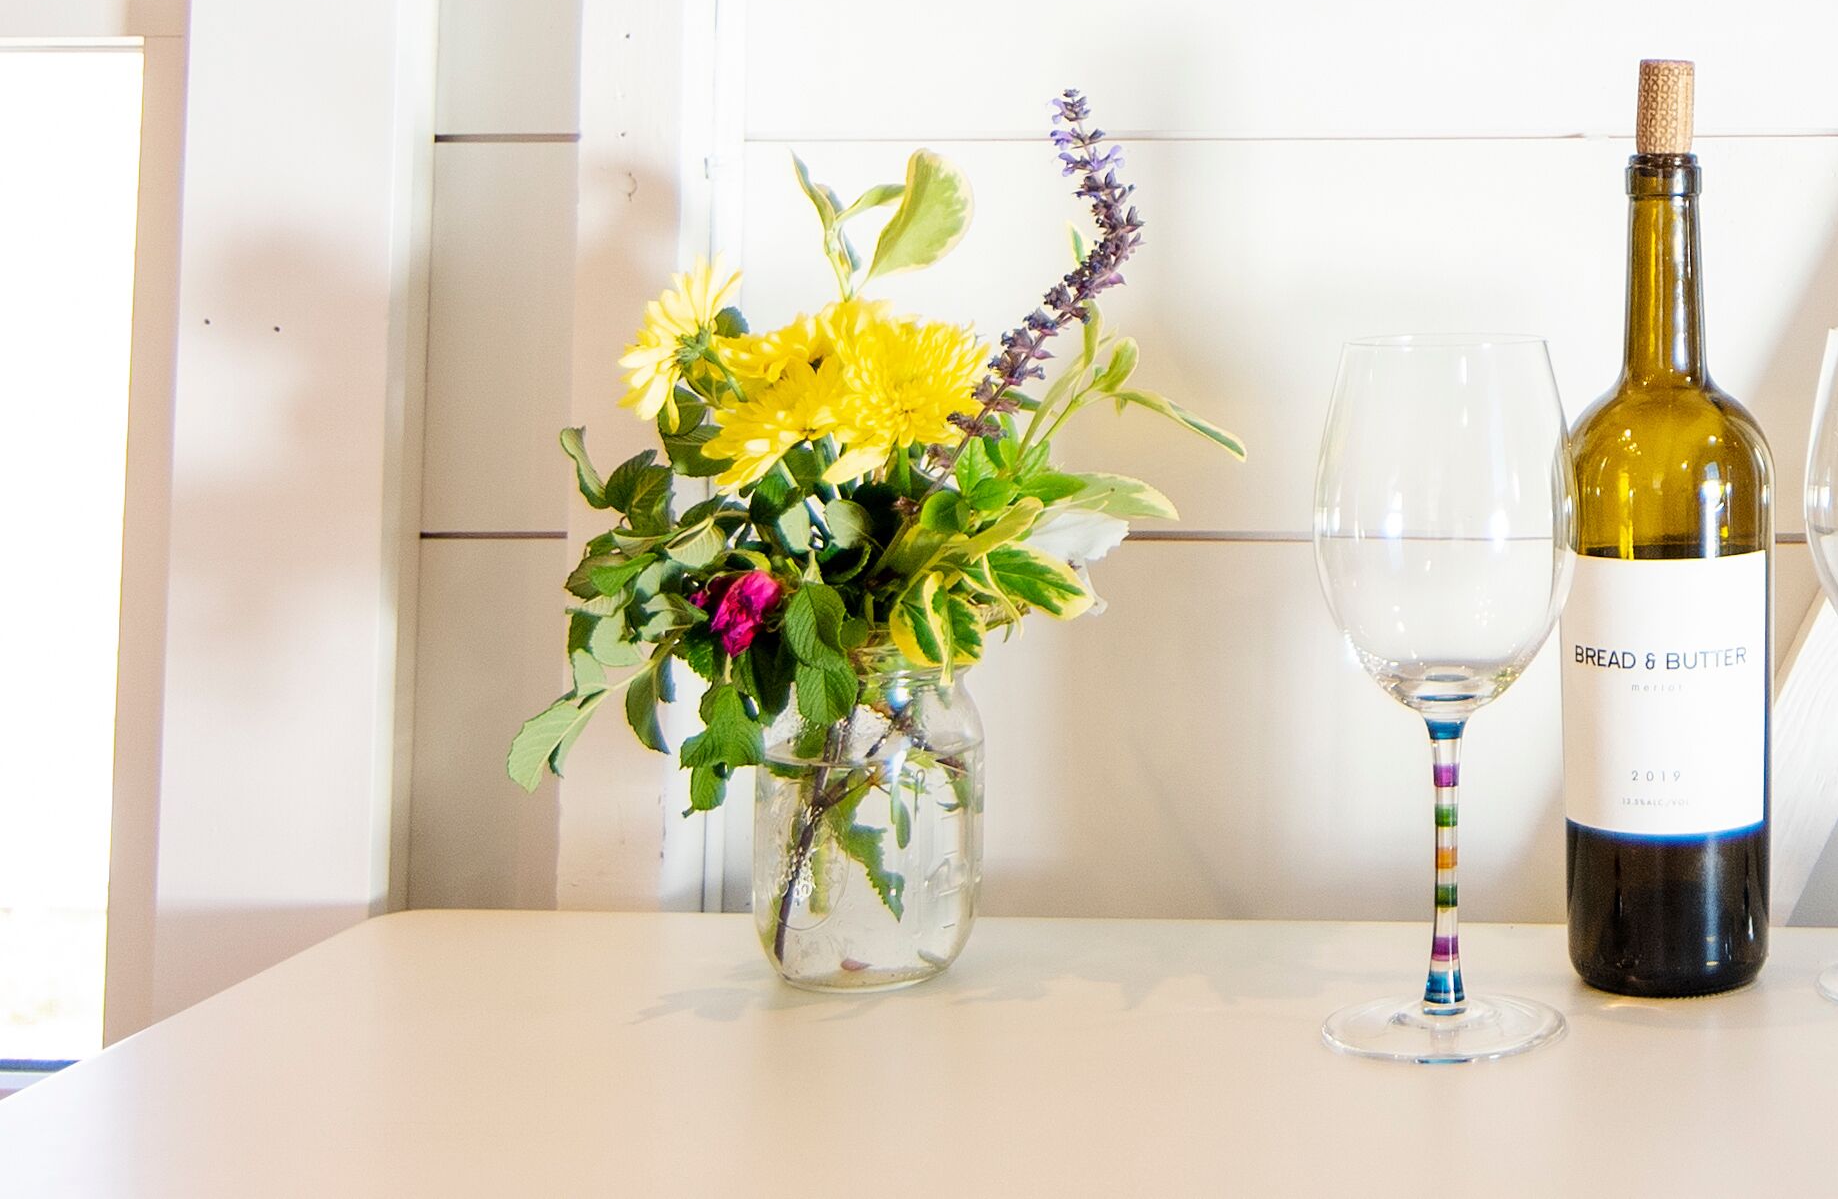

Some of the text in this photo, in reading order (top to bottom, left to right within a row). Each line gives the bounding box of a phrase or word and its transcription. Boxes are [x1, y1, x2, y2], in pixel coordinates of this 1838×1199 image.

[1575, 645, 1747, 670] BREAD & BUTTER
[1631, 770, 1681, 782] 2019
